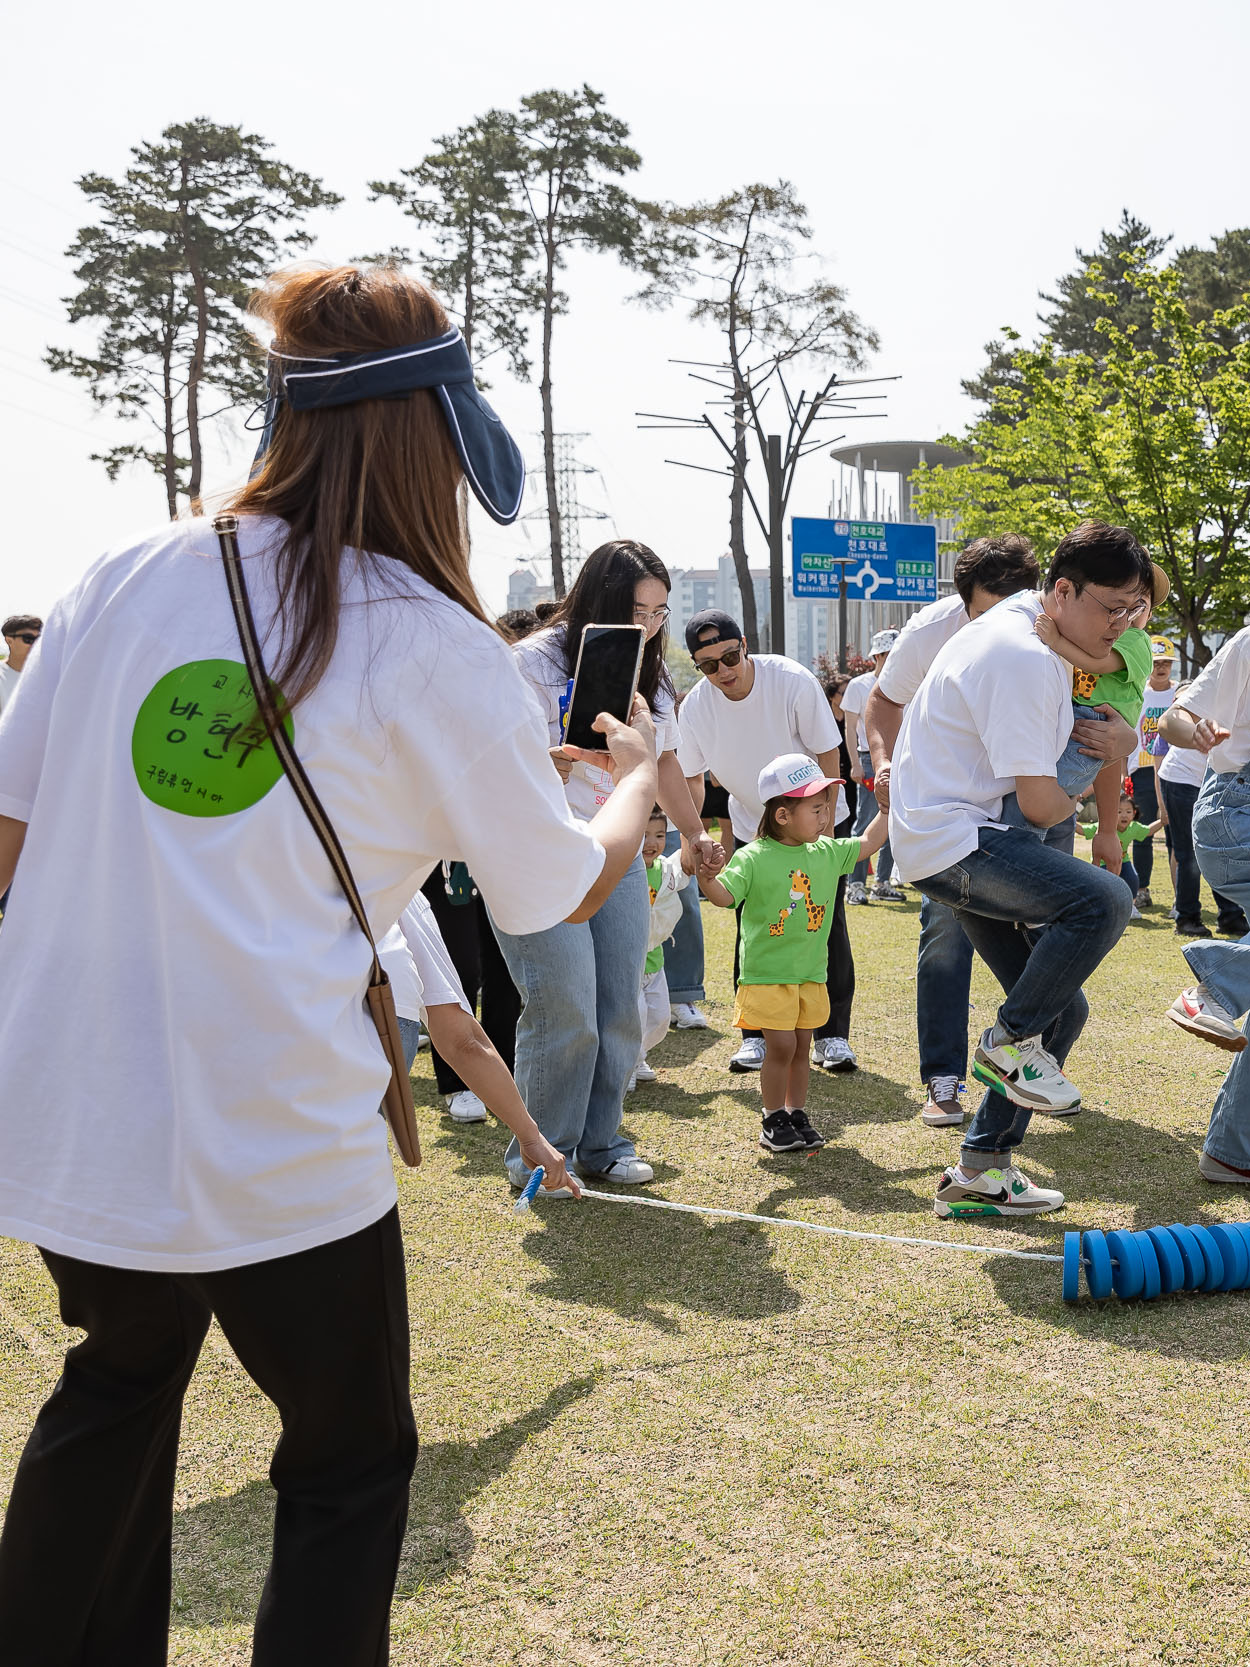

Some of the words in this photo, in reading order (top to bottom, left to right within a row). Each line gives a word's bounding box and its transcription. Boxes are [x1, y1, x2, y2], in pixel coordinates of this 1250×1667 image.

[852, 525, 883, 536] 천호대교
[848, 539, 888, 551] 천호대로
[803, 557, 831, 569] 아차산
[797, 573, 839, 586] 워커힐로
[896, 578, 935, 590] 워커힐로
